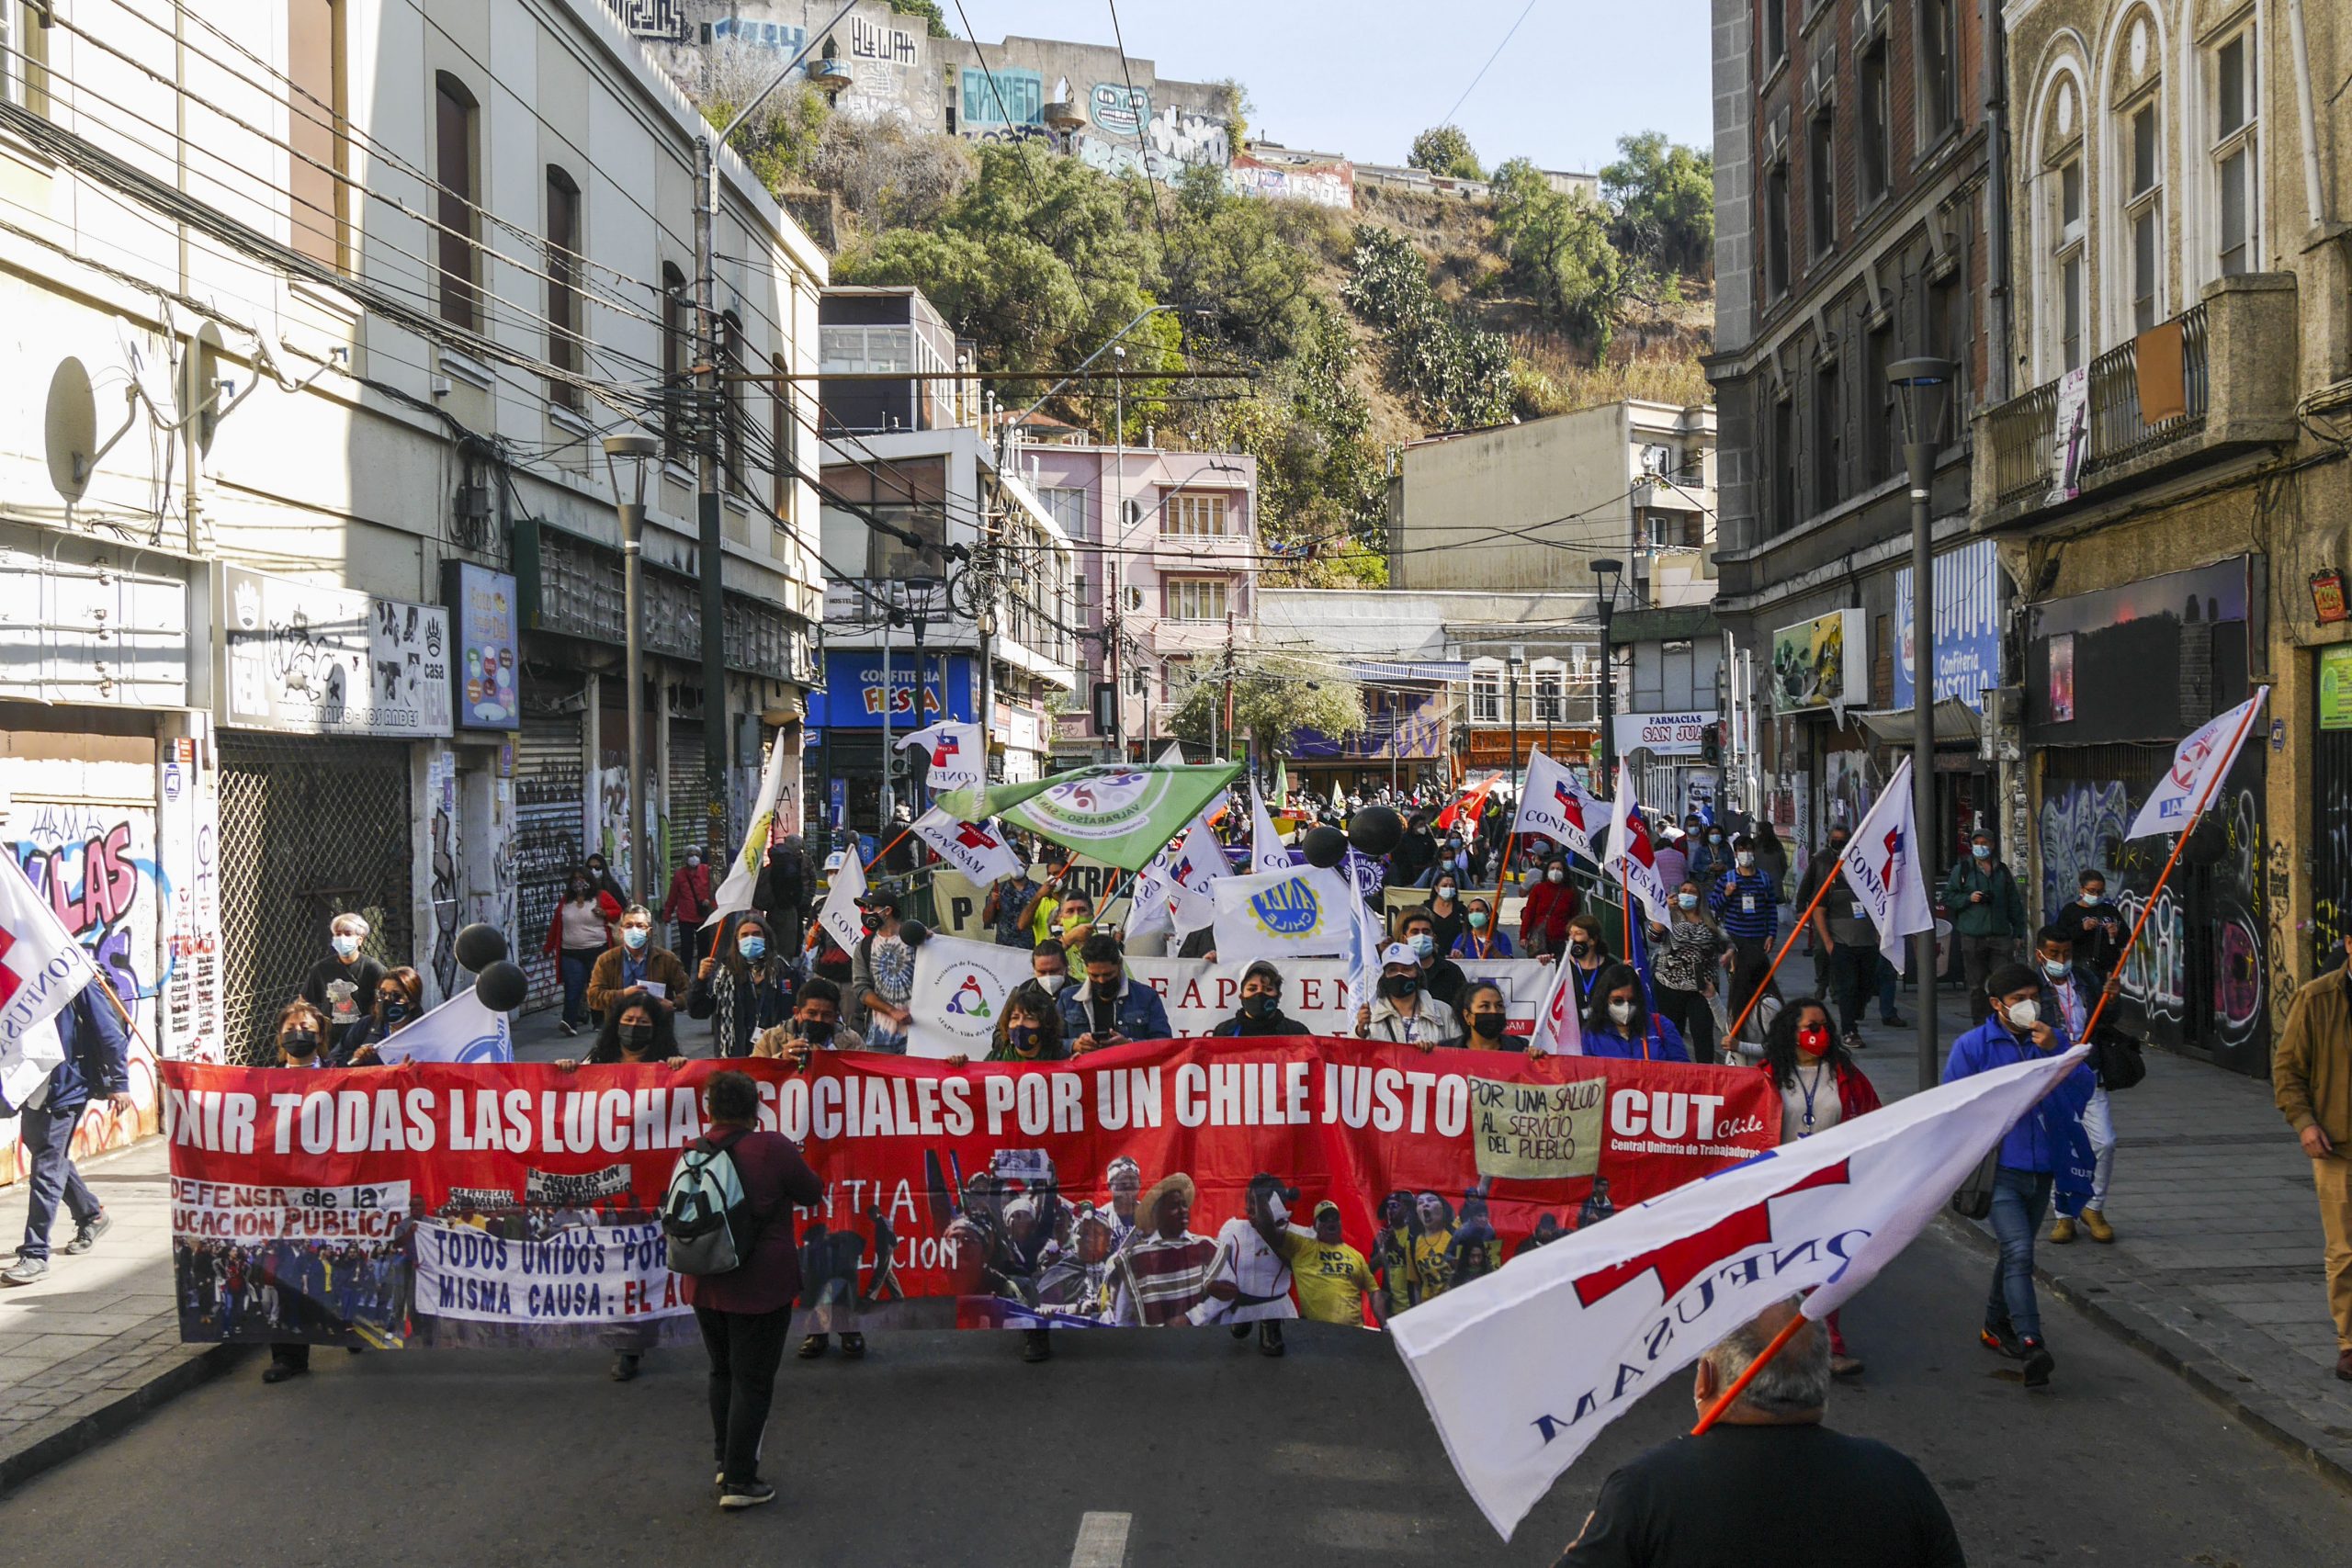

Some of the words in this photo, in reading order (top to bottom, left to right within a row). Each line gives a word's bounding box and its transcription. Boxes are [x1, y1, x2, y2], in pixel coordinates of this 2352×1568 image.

[424, 662, 445, 680] casa
[1940, 647, 1979, 675] Confitería
[860, 668, 941, 683] CONFITEÍA
[277, 701, 353, 727] ARAISO
[384, 708, 419, 727] ANDES
[424, 682, 449, 726] REAL
[862, 686, 941, 714] FIESTA
[1643, 727, 1672, 742] SAN
[1649, 716, 1702, 725] FARMACIAS
[924, 826, 986, 874] CONFUSAM
[270, 1087, 436, 1155] TODAS
[449, 1088, 532, 1154] LAS
[756, 1075, 975, 1141] SOCIALES
[984, 1071, 1084, 1136] POR
[1097, 1065, 1162, 1131] UN
[1174, 1061, 1310, 1127] CHILE
[1321, 1062, 1469, 1138] JUSTO
[1469, 1078, 1504, 1109] POR
[1516, 1089, 1548, 1113] UNA
[1550, 1083, 1600, 1112] SALUD
[1481, 1113, 1498, 1134] AL
[1611, 1089, 1725, 1141] CUT
[1716, 1115, 1764, 1139] Chile
[1487, 1136, 1511, 1155] DEL
[1519, 1137, 1576, 1161] PUEBLO
[1611, 1137, 1645, 1153] Central
[1646, 1139, 1685, 1155] Unitaria
[1687, 1143, 1699, 1156] de
[528, 1168, 541, 1180] EL
[546, 1174, 582, 1187] AGUA
[584, 1171, 600, 1185] ES
[603, 1166, 621, 1180] UN
[170, 1177, 289, 1208] DEFENSA
[302, 1188, 338, 1209] de
[353, 1187, 378, 1209] la
[283, 1206, 403, 1238] PÚBLICA
[434, 1228, 508, 1272] TODOS
[521, 1240, 605, 1276] UNIDOS
[623, 1236, 668, 1272] POR
[1319, 1261, 1355, 1274] AFP
[438, 1273, 513, 1315] MISMA
[624, 1278, 652, 1315] EL
